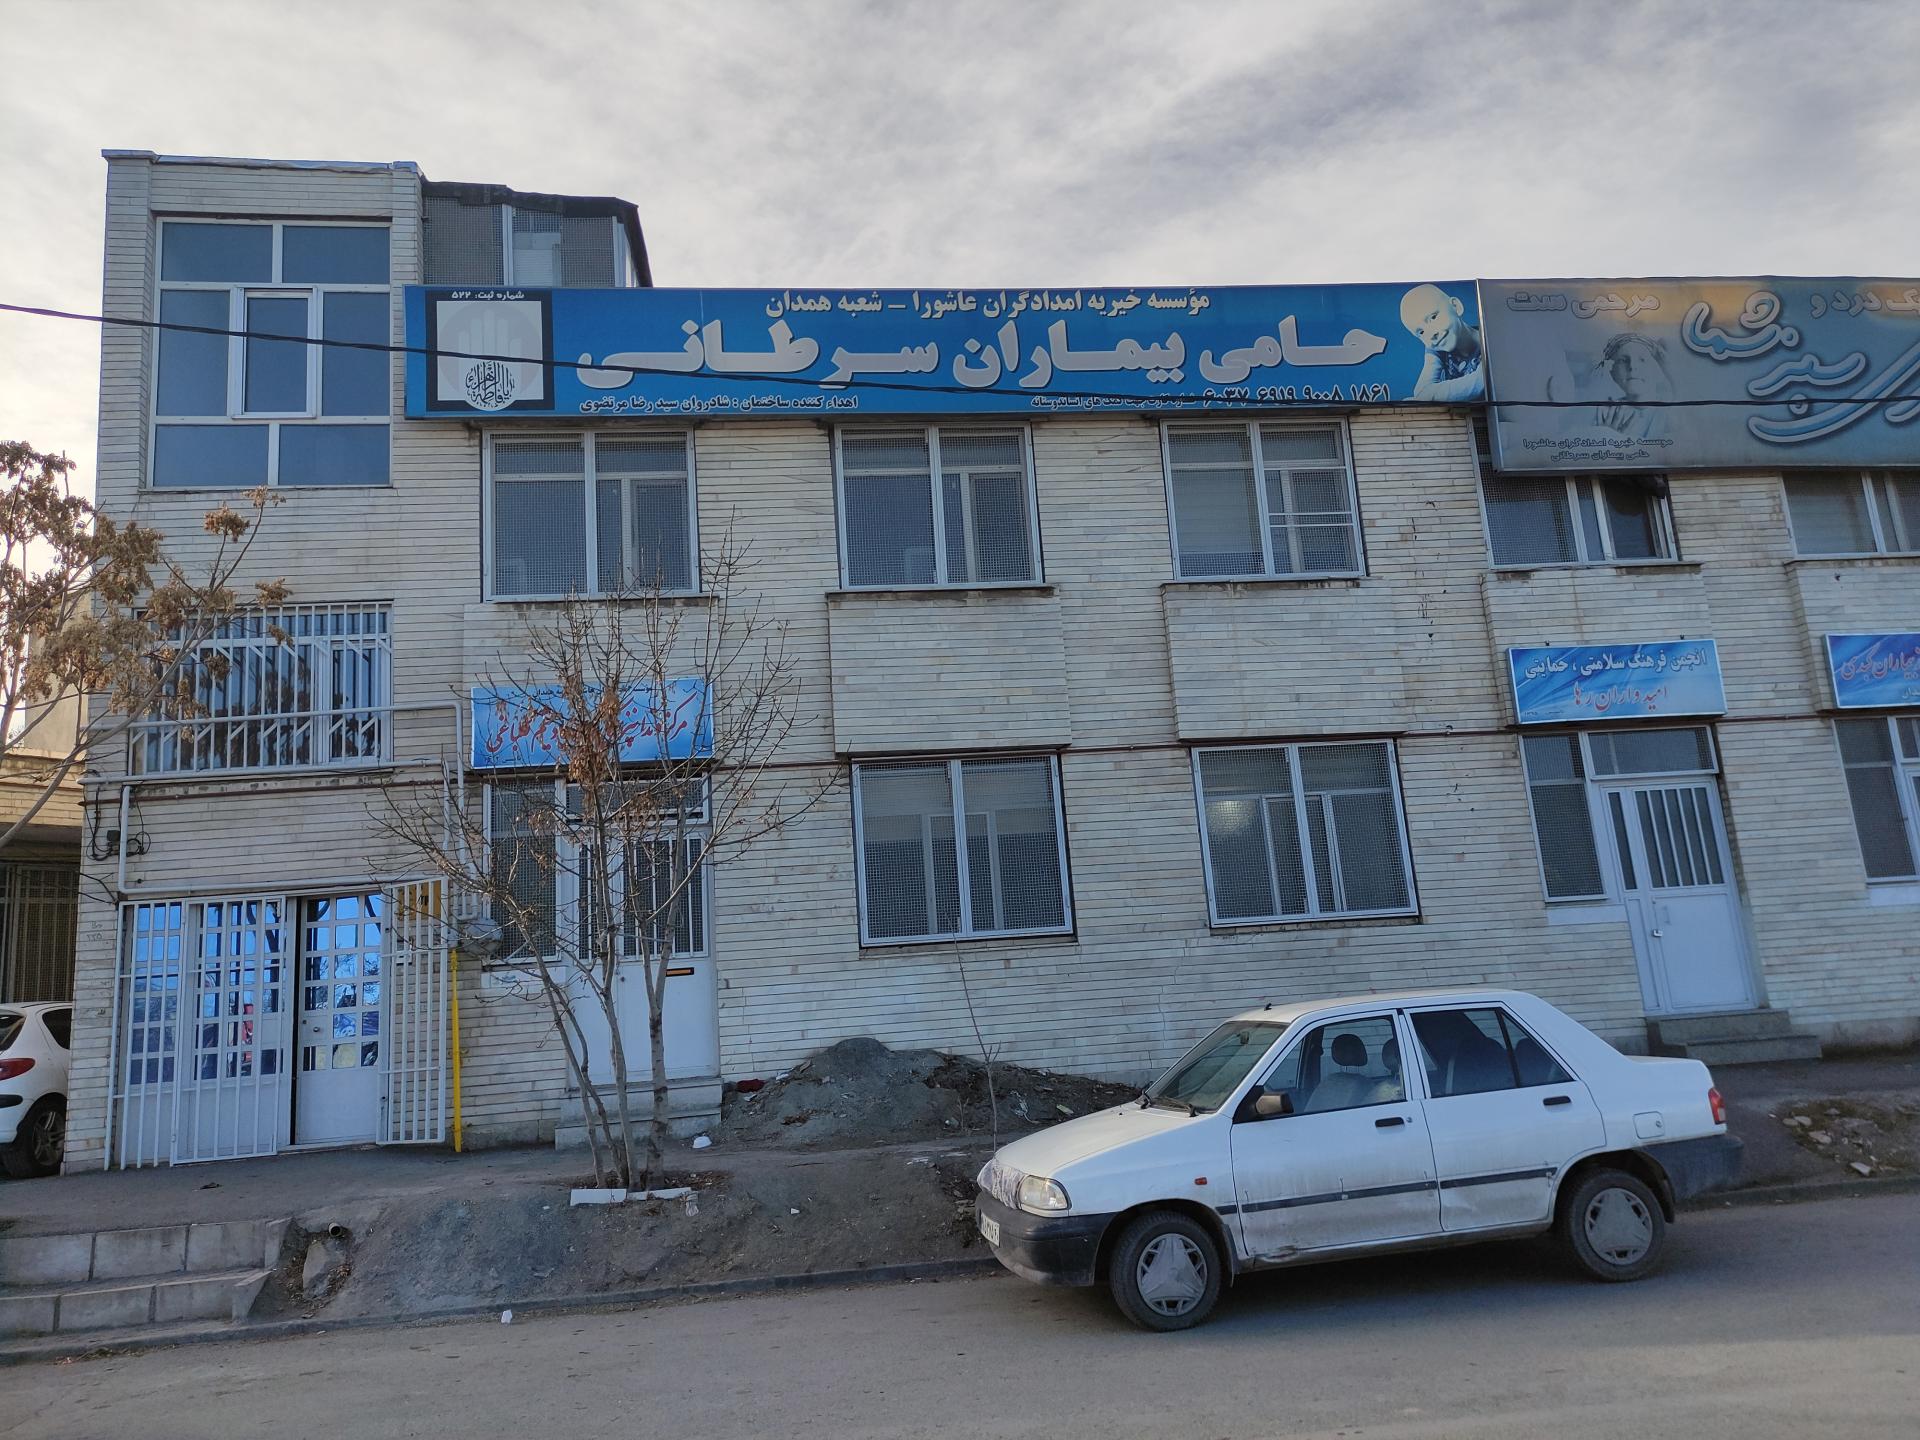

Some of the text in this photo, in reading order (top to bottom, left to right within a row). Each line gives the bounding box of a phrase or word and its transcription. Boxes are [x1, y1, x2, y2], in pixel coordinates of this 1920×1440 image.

[451, 291, 471, 299] ۵۲۲
[496, 290, 525, 301] شماره
[765, 290, 832, 318] همدان
[838, 290, 882, 318] شعبه
[912, 289, 977, 319] عاشورا
[983, 289, 1082, 318] امدادگران
[1088, 289, 1141, 316] خیریه
[576, 315, 1388, 389] حامی بیماران سرطانی
[579, 397, 629, 413] مرتضوی
[629, 396, 654, 413] رضا
[655, 398, 679, 412] سید
[680, 396, 730, 413] شادروان
[742, 395, 790, 411] ساختمان
[791, 395, 824, 410] کننده
[1524, 656, 1568, 679] حمایتی
[1580, 652, 1625, 676] سلامتی
[1628, 650, 1668, 673] فرهنگ
[1671, 648, 1707, 672] انجمن
